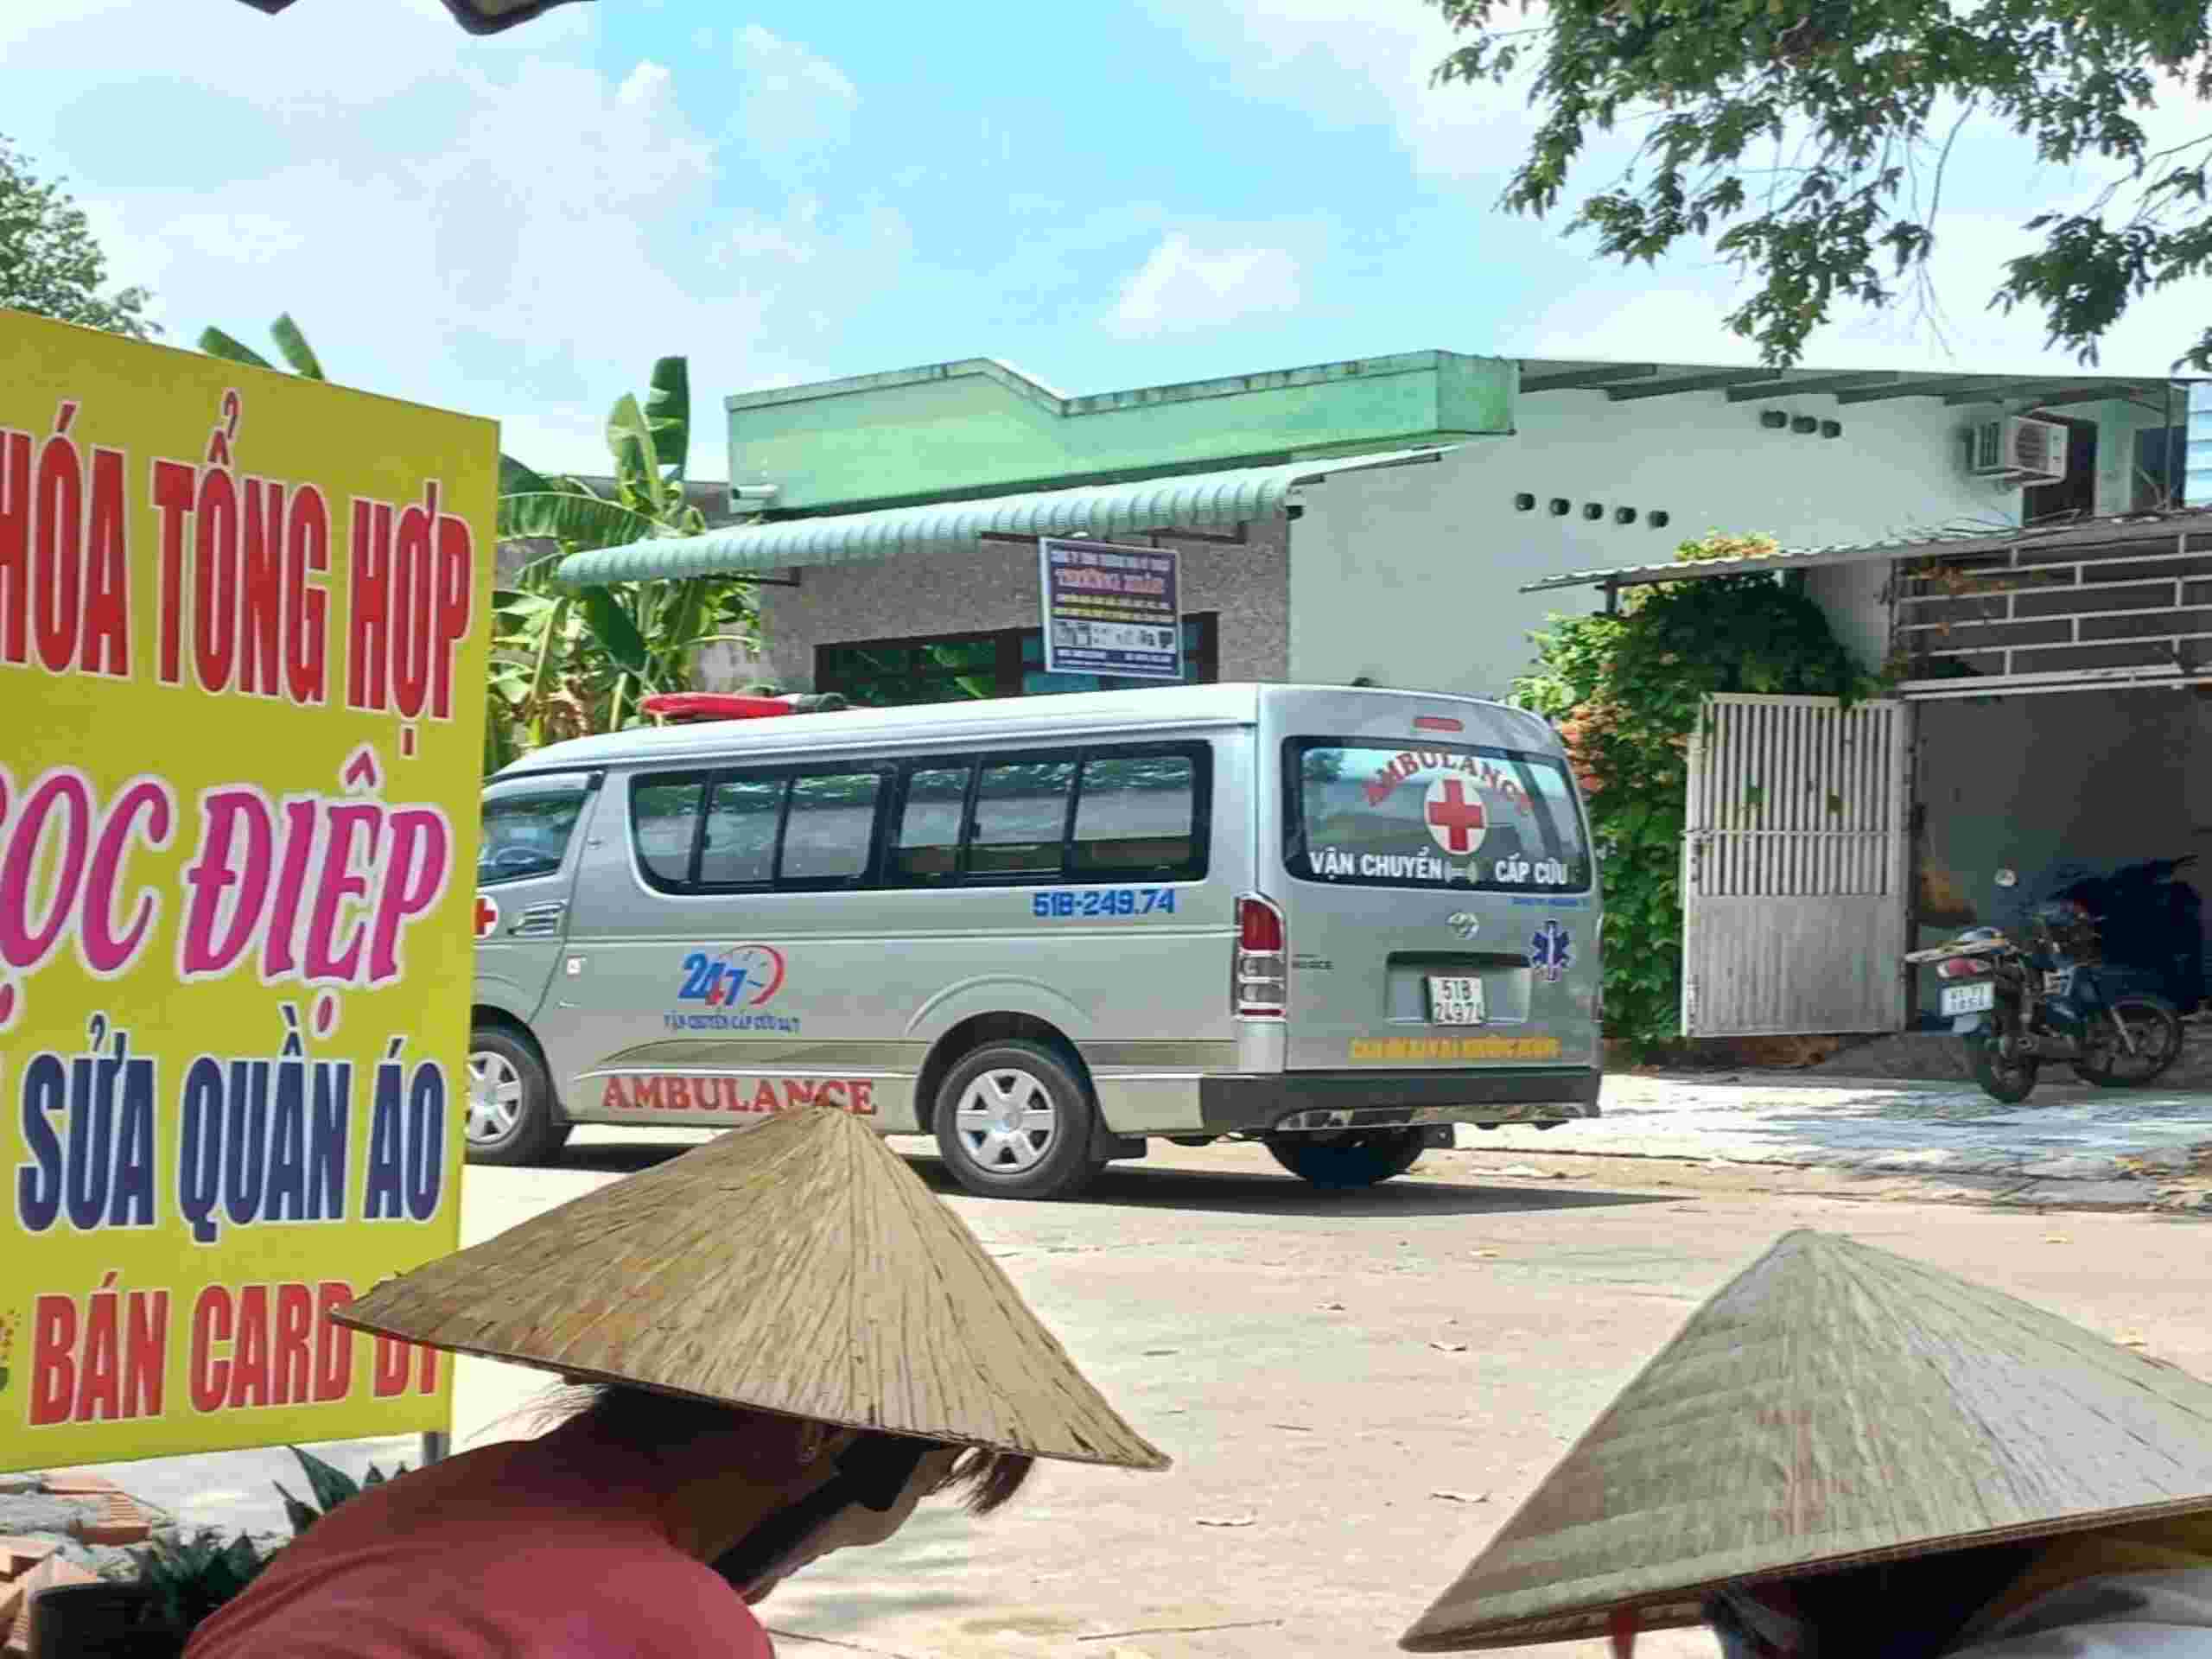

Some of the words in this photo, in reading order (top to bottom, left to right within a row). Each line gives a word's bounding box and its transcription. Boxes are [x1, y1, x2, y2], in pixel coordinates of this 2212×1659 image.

[154, 391, 327, 703] TỔNG
[349, 481, 472, 756] HỢP
[0, 773, 169, 1024] ỌC
[183, 750, 447, 1033] ĐIỆP
[1309, 846, 1355, 880] VẬN
[1360, 845, 1443, 880] CHUYỂN
[1495, 851, 1530, 883] CẤP
[18, 1014, 156, 1232] SỬA
[179, 1004, 352, 1244] QUẦN
[363, 1037, 446, 1221] ÁO
[601, 1076, 878, 1116] AMBULANCE
[29, 1271, 169, 1427] BÁN
[190, 1282, 354, 1414] CARD
